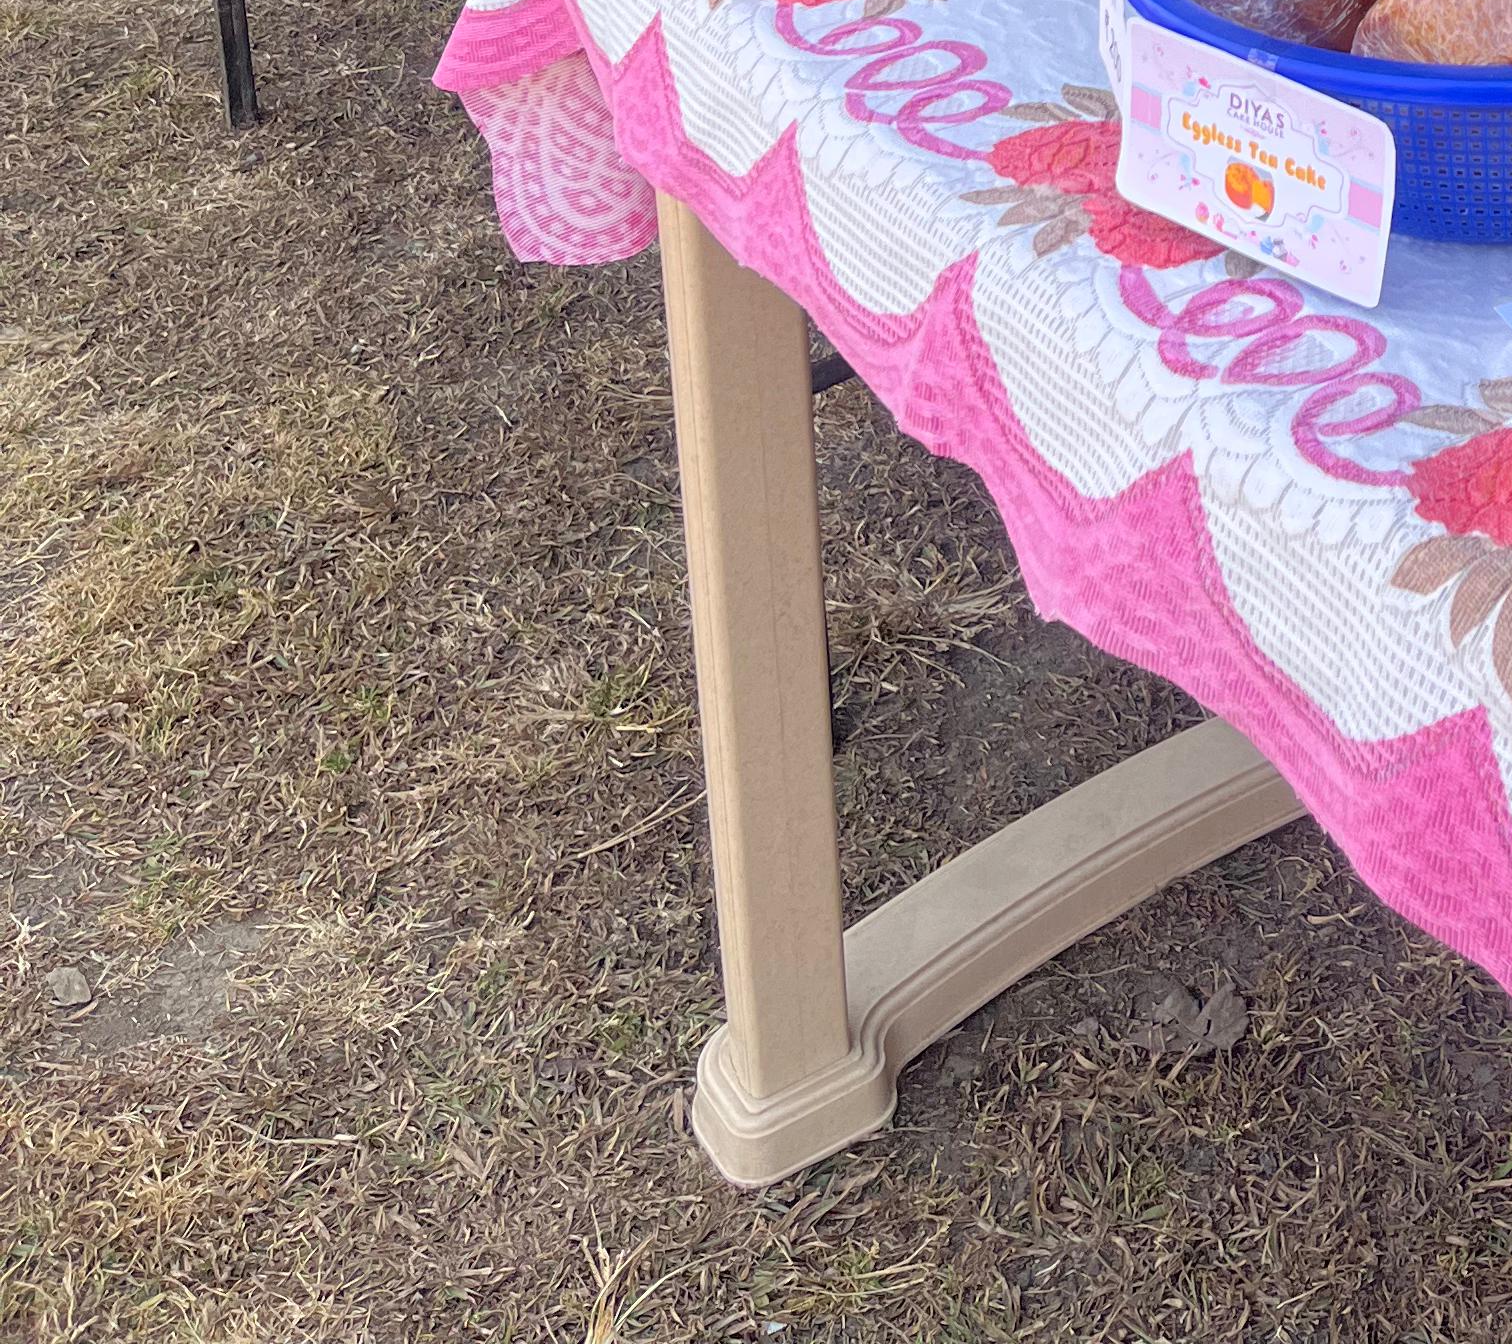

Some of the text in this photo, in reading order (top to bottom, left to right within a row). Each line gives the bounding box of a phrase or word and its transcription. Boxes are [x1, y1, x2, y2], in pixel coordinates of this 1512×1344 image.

[1230, 92, 1285, 129] DIYAS
[1182, 111, 1242, 154] Eggless
[1284, 156, 1326, 191] Cake
